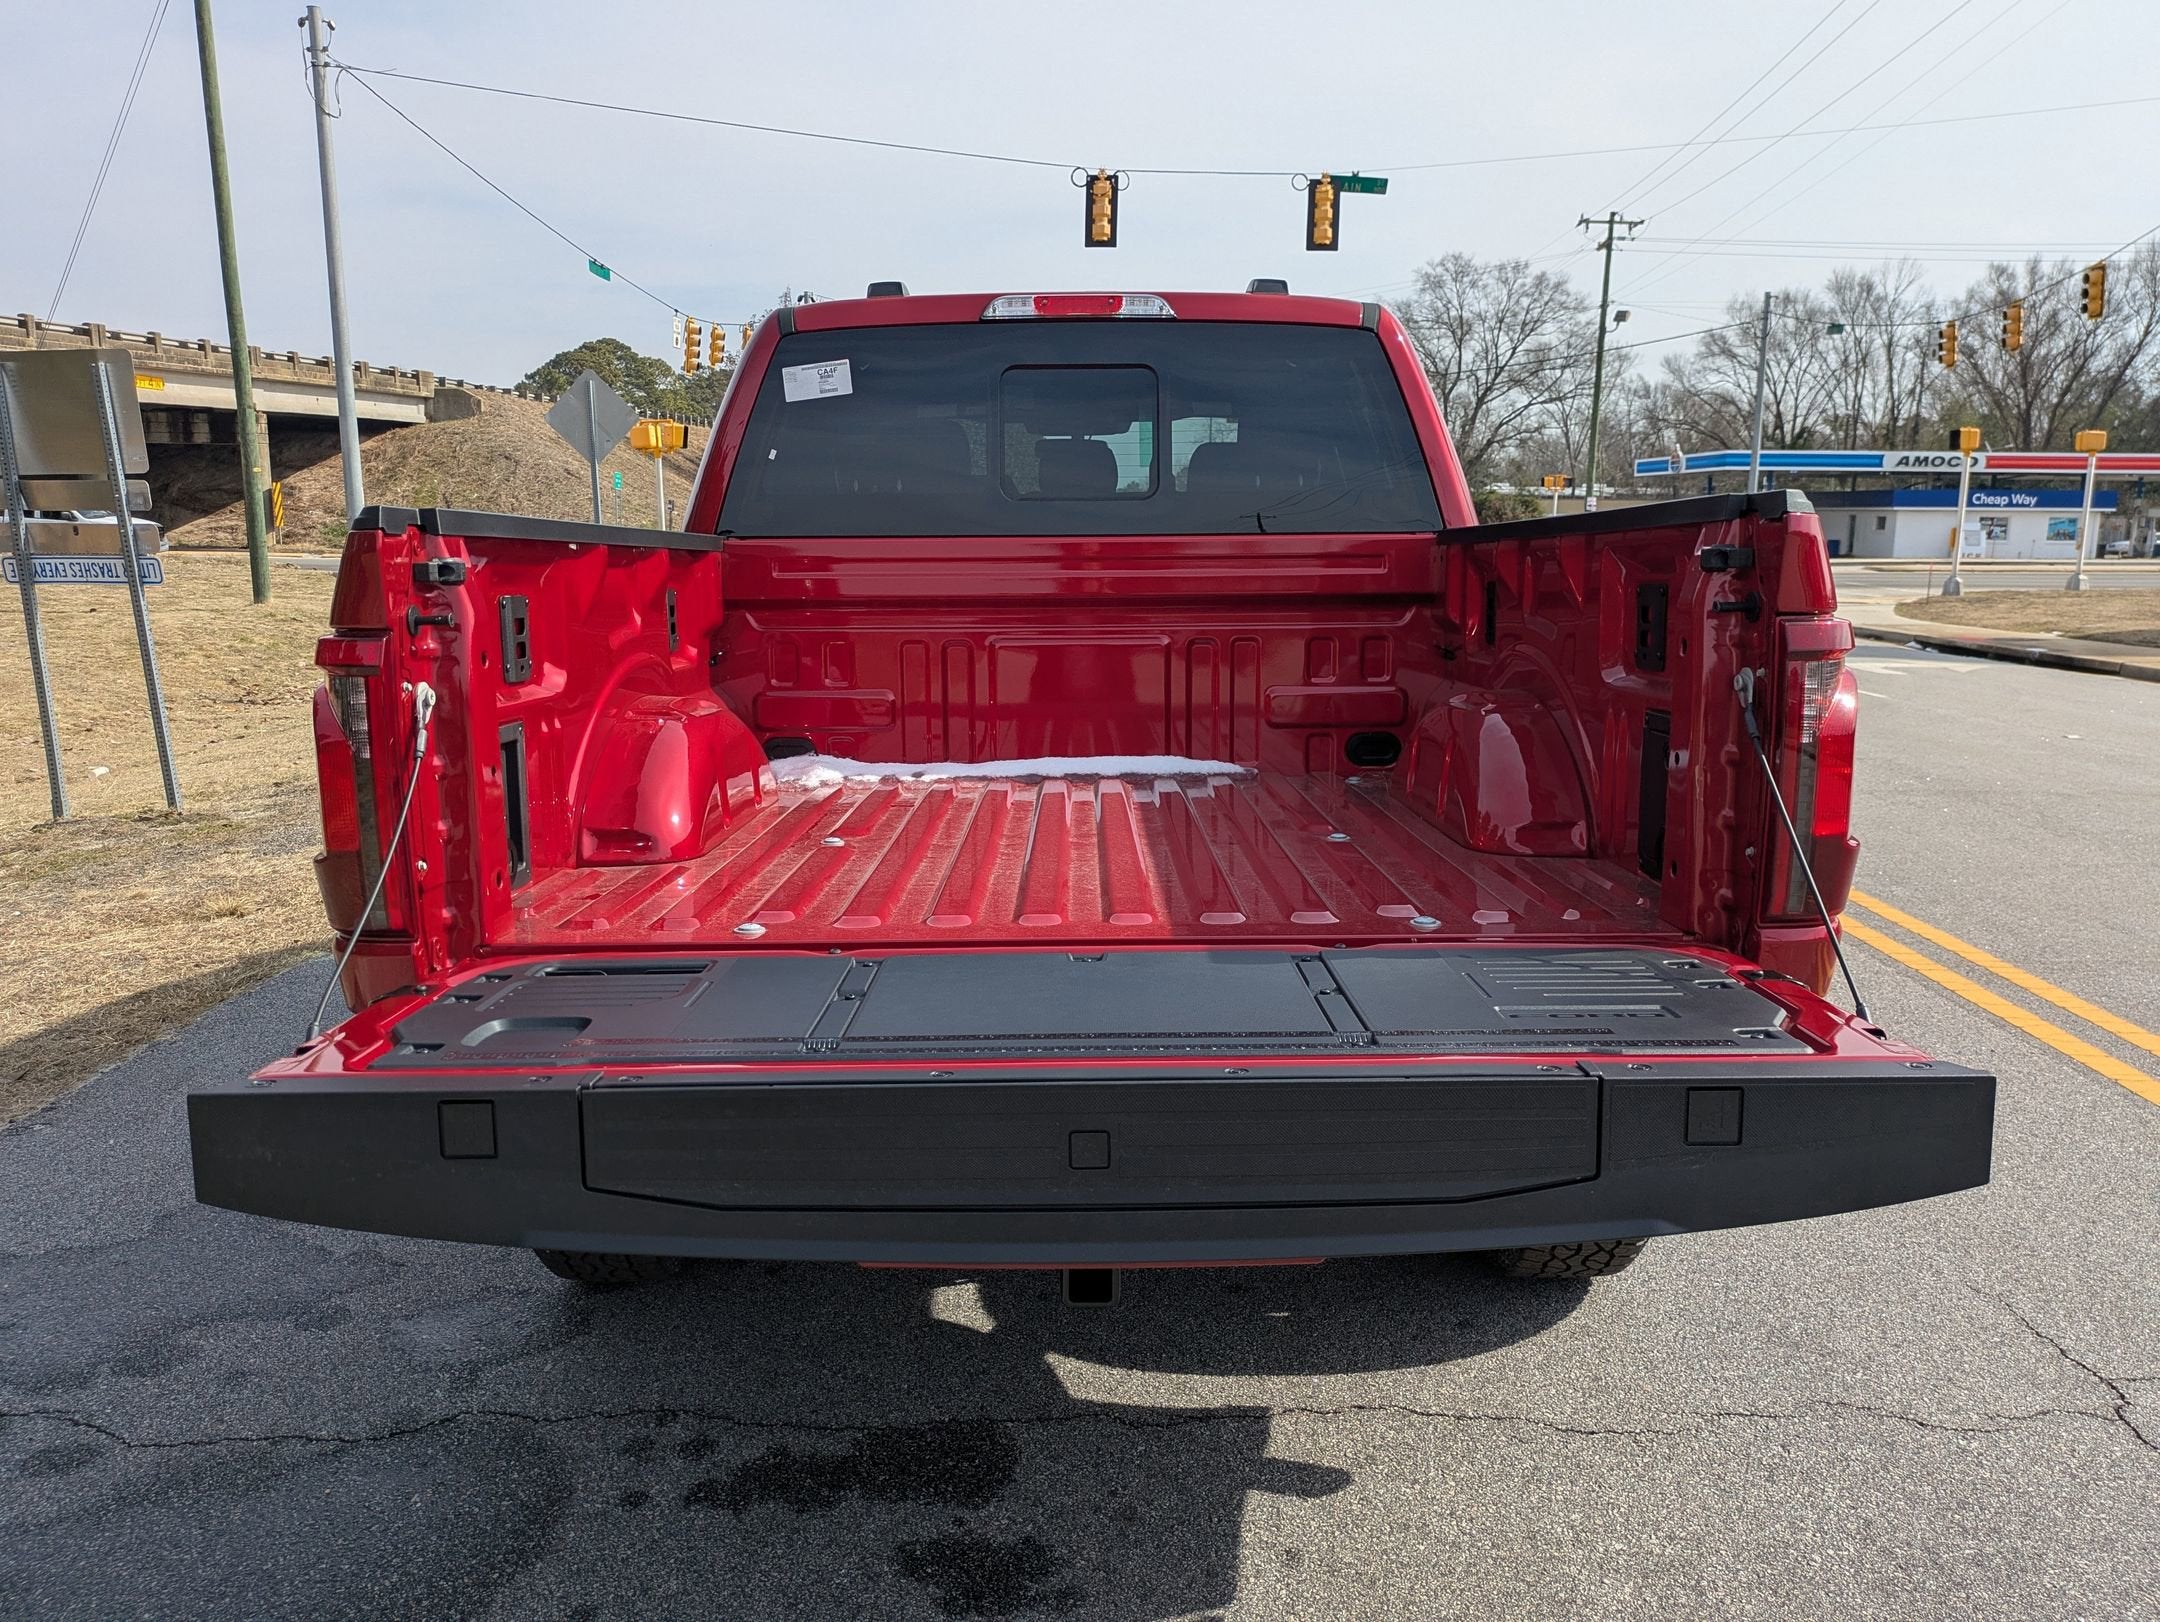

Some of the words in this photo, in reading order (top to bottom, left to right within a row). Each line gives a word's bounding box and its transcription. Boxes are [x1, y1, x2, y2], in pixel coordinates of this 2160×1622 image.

[1342, 182, 1362, 192] AIN
[1972, 493, 2009, 507] Cheap
[2011, 493, 2037, 507] Way
[69, 563, 120, 578] TRASHES
